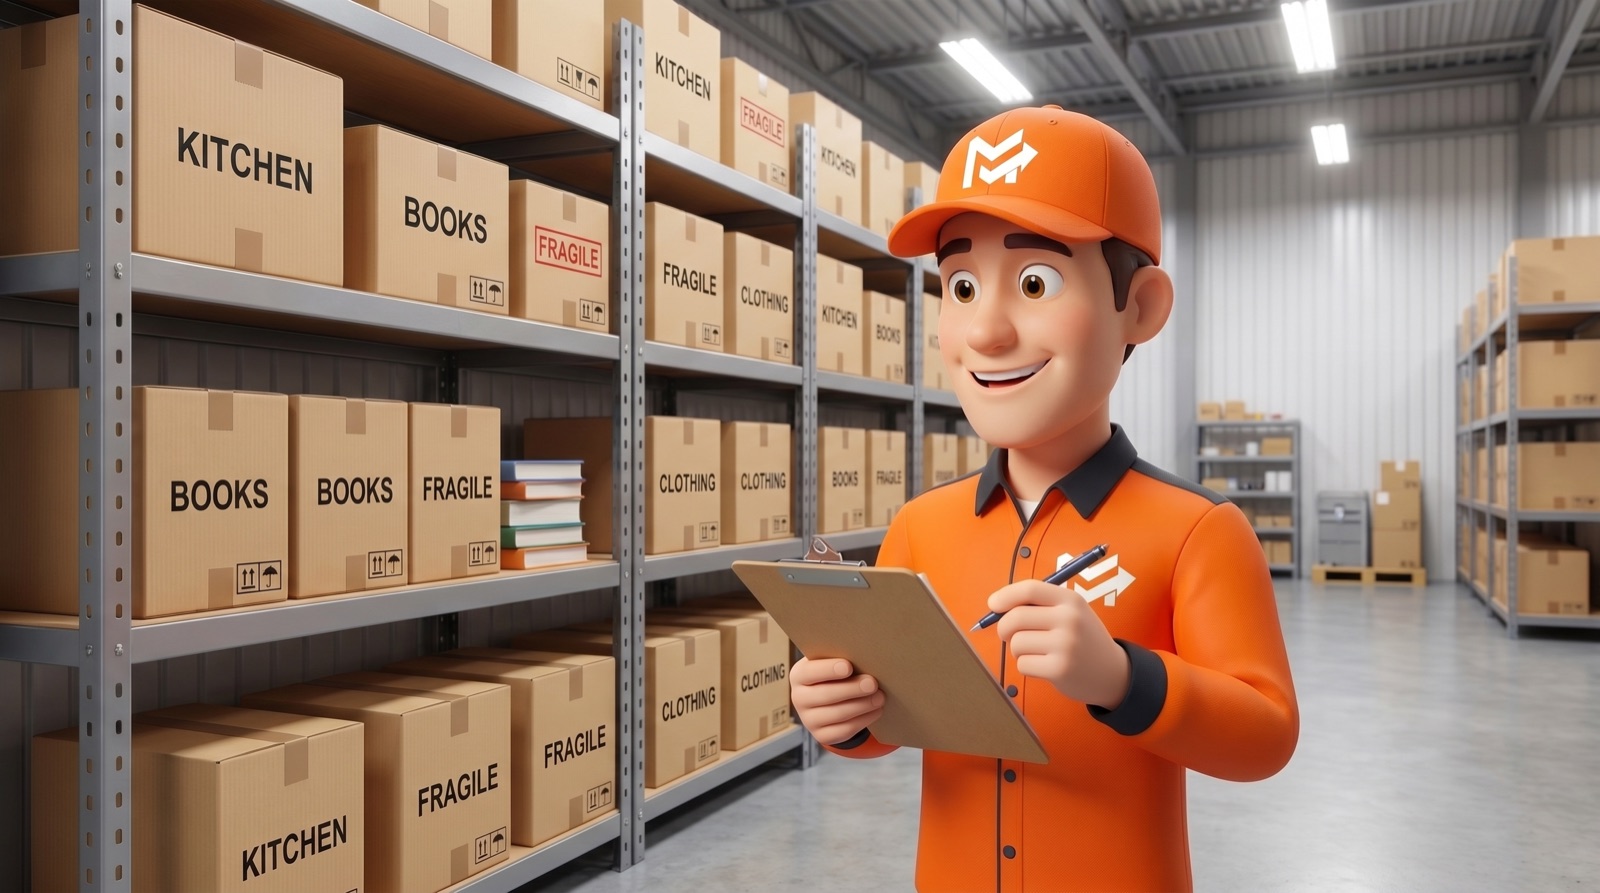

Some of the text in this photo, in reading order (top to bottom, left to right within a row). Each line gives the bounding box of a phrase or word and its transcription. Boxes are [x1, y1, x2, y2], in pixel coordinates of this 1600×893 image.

[655, 52, 711, 102] KITCHEN
[743, 105, 783, 141] FRAGILE
[178, 127, 313, 195] KITCHEN
[404, 195, 488, 244] BOOKS
[539, 235, 600, 270] FRAGILE
[663, 262, 717, 297] FRAGILE
[741, 286, 789, 314] CLOTHING
[822, 306, 857, 330] KITCHEN
[876, 323, 901, 346] BOOKS
[317, 476, 393, 506] BOOKS
[423, 475, 493, 502] FRAGILE
[659, 473, 716, 495] CLOTHING
[741, 472, 786, 491] CLOTHING
[832, 470, 859, 489] BOOKS
[876, 470, 902, 485] FRAGILE
[171, 478, 269, 512] BOOKS
[741, 662, 787, 692] CLOTHING
[662, 686, 716, 722] CLOTHING
[544, 725, 606, 769] FRAGILE
[418, 763, 499, 818] FRAGILE
[242, 815, 348, 882] KITCHEN
